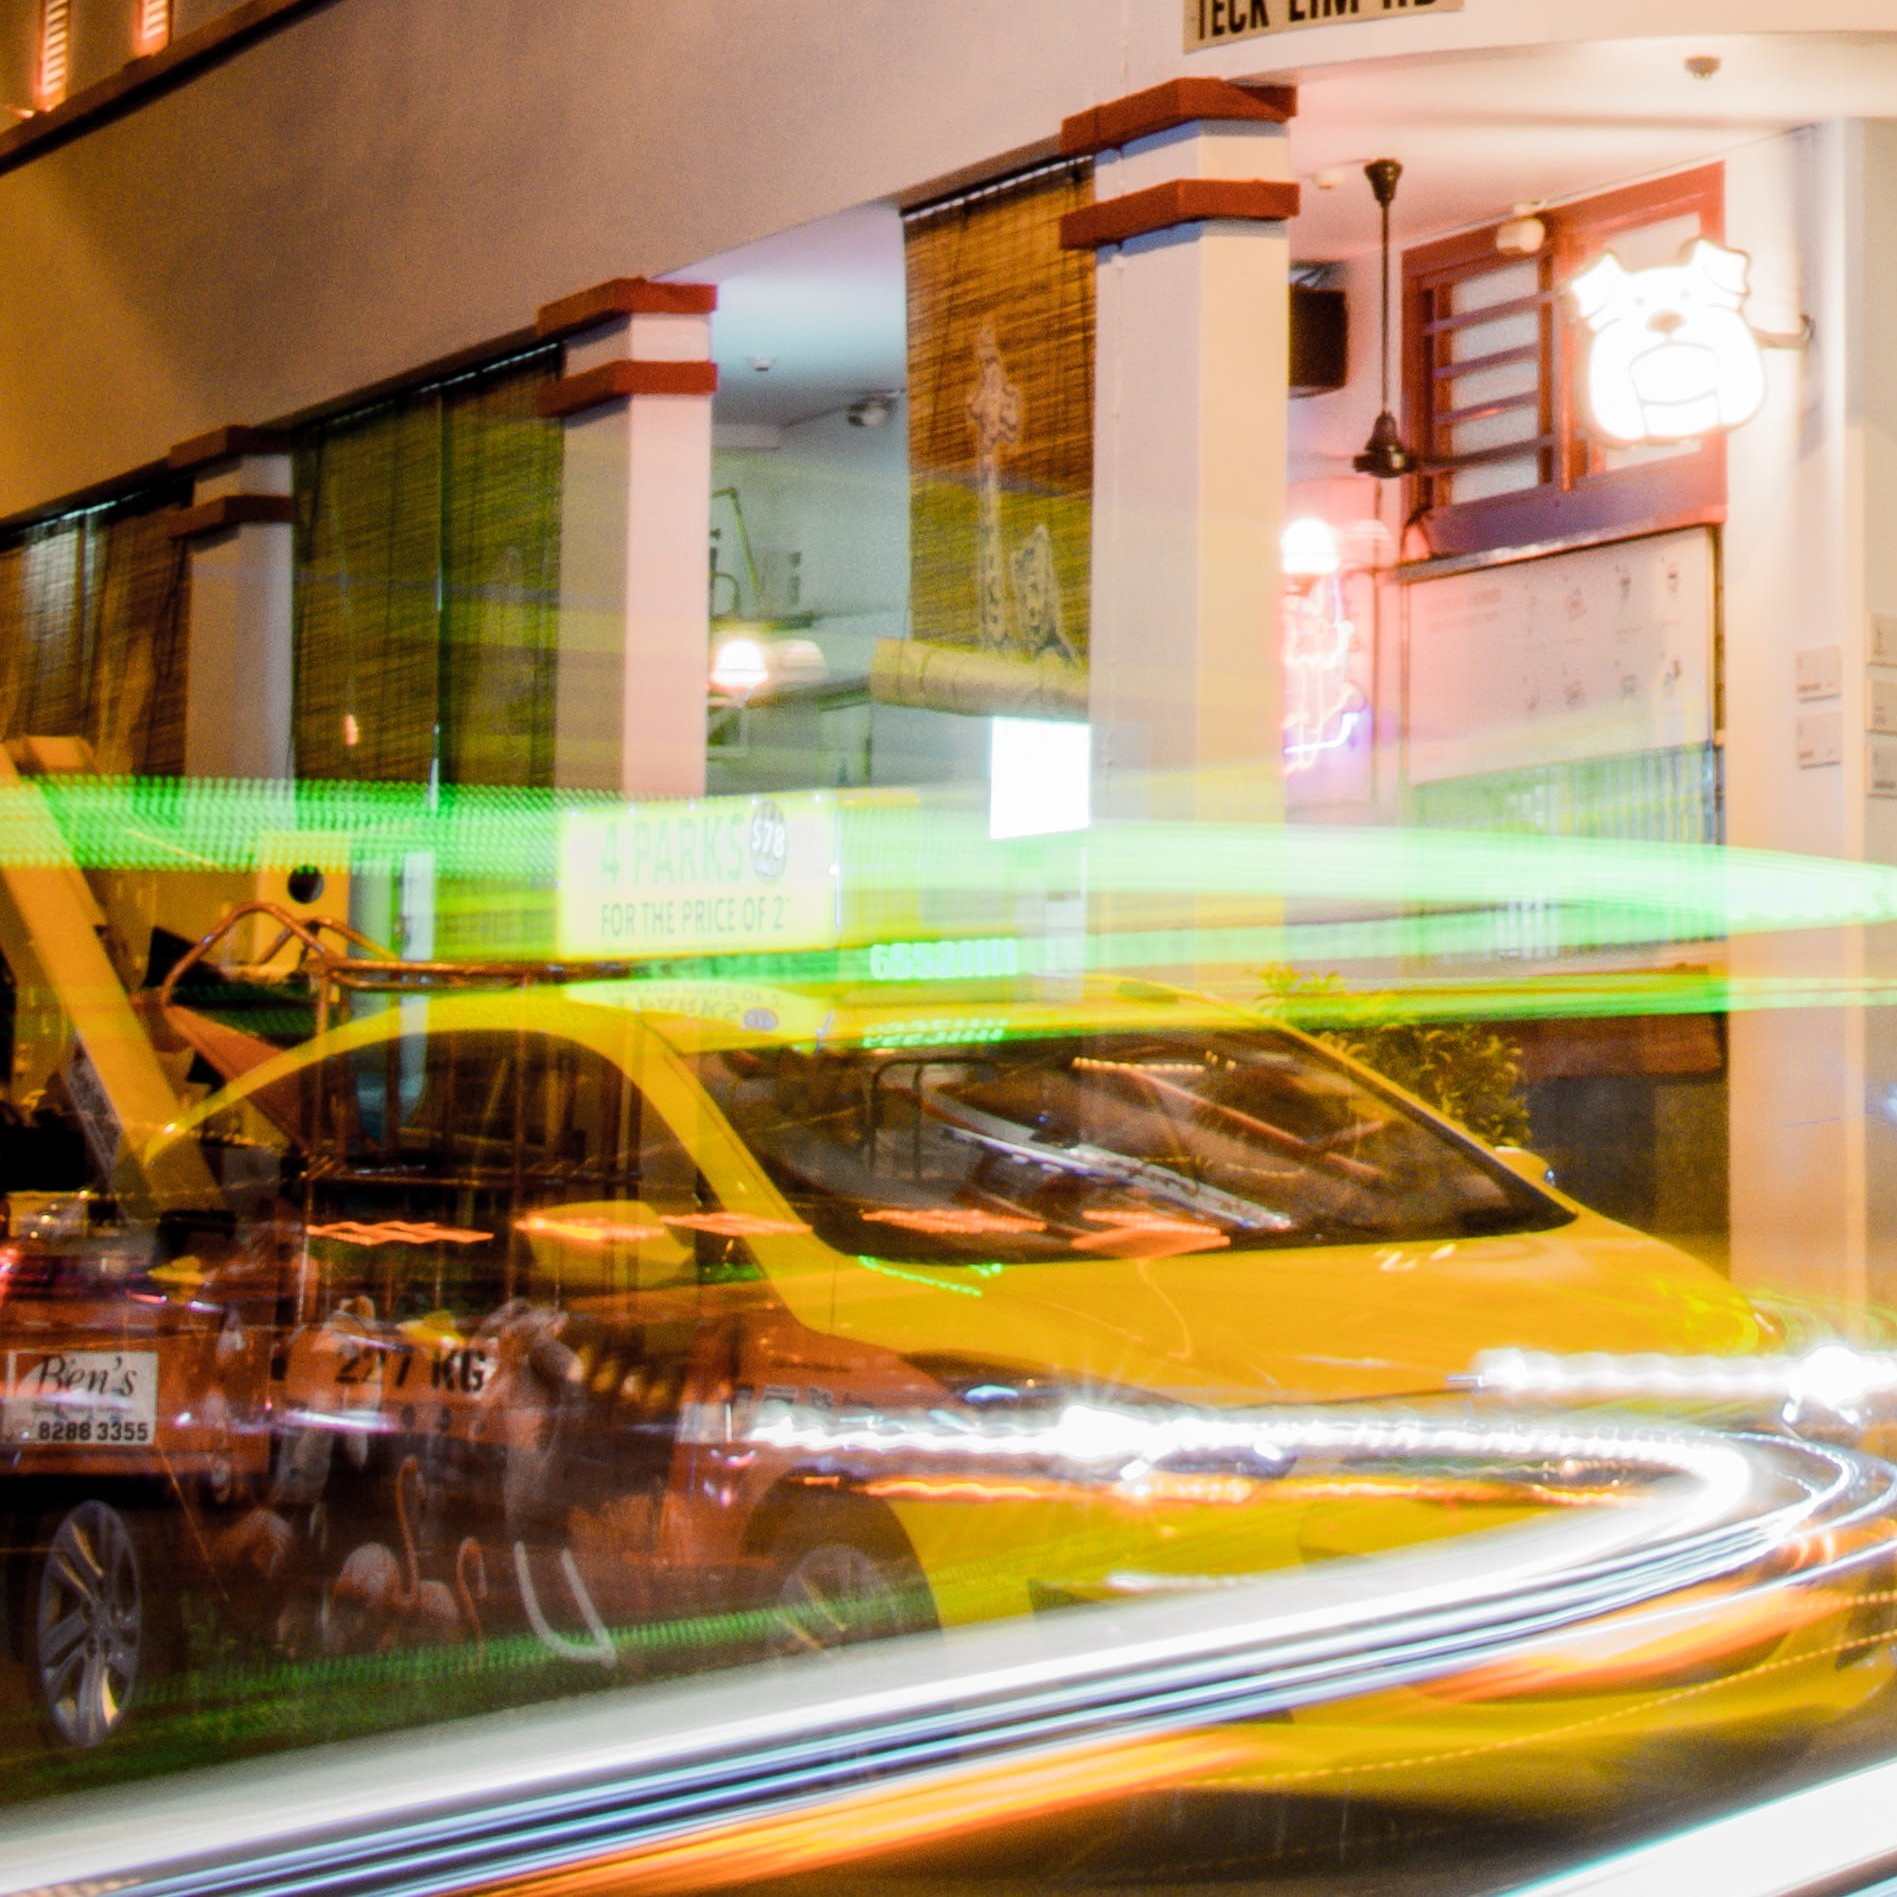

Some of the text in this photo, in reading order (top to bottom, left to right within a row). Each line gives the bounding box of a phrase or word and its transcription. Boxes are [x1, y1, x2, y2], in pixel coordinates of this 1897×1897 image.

[601, 813, 745, 886] 4 PARKS
[601, 902, 636, 938] FOR
[642, 901, 675, 935] THE
[682, 897, 735, 935] PRICE
[742, 895, 766, 932] OF
[38, 1421, 149, 1442] 8288 3355
